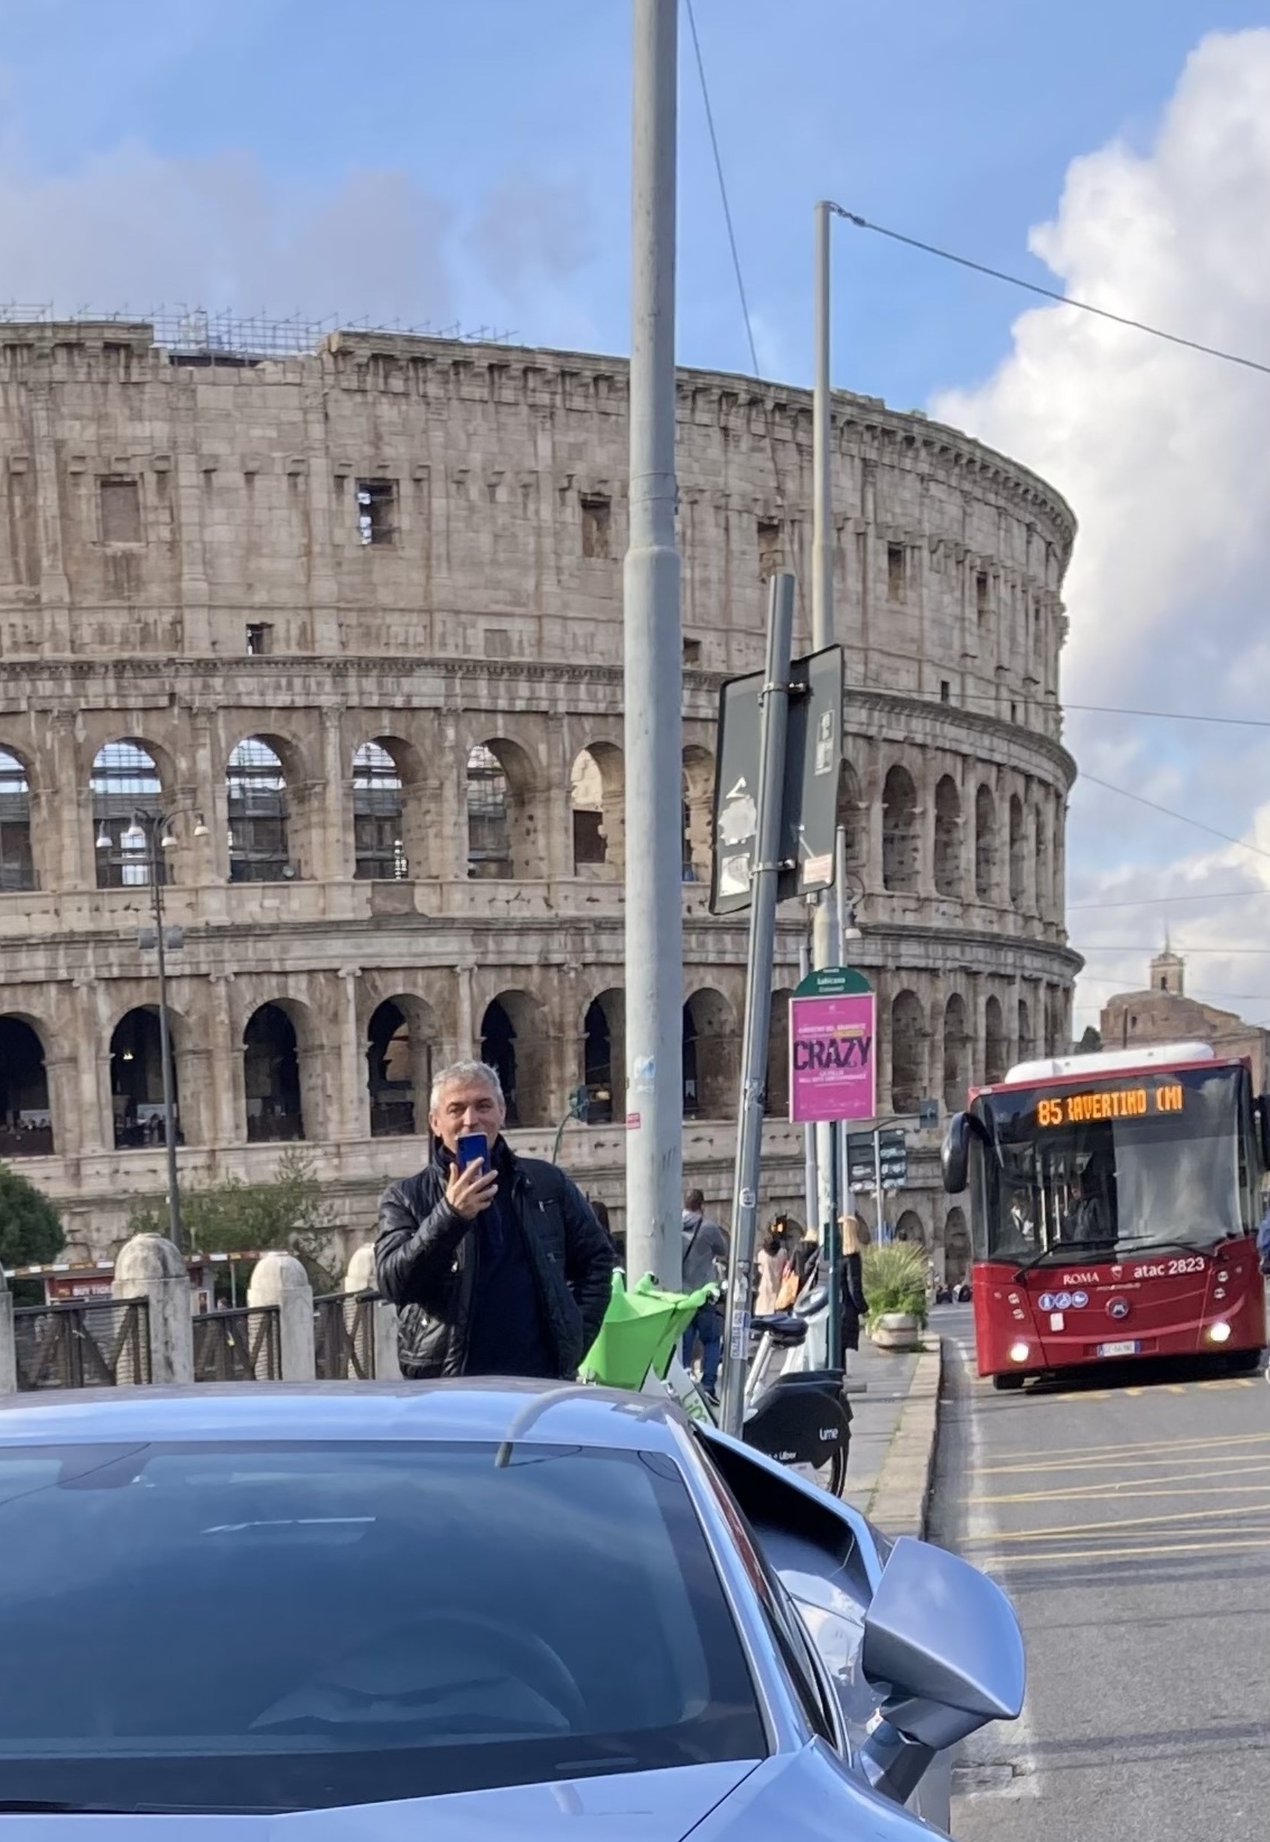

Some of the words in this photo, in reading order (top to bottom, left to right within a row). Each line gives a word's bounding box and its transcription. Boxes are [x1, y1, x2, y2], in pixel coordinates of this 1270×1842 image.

[793, 1036, 872, 1070] CRAZY
[1038, 1099, 1063, 1126] 85
[1063, 1272, 1099, 1285] ROMA
[1134, 1264, 1165, 1279] atac
[1168, 1257, 1205, 1275] 2823
